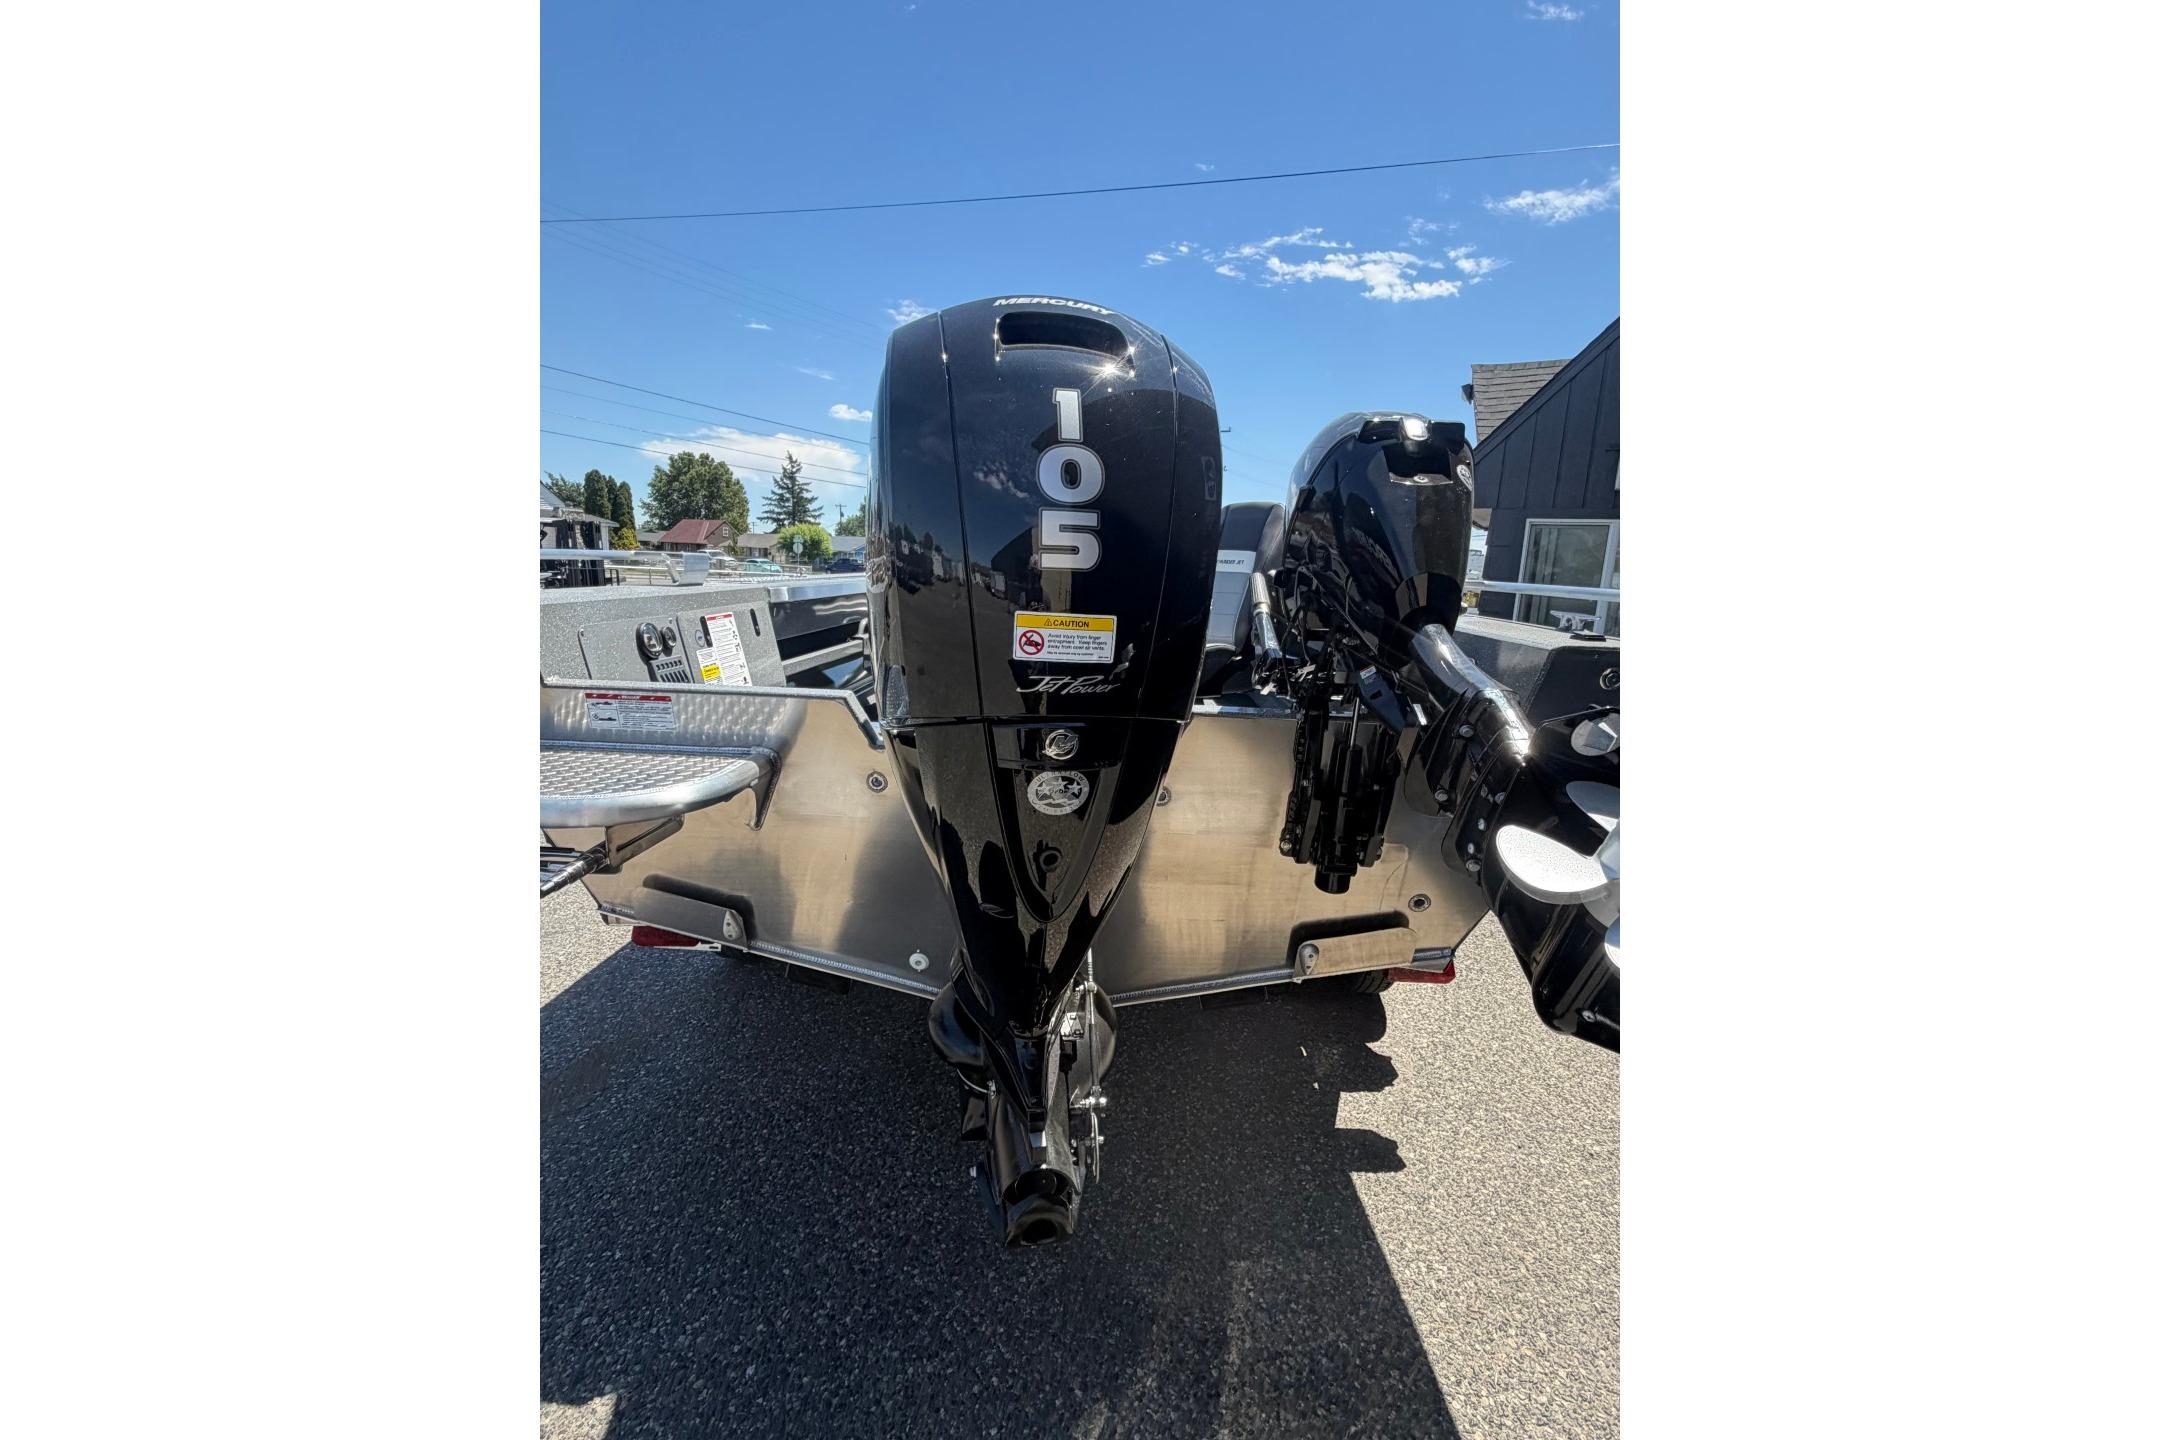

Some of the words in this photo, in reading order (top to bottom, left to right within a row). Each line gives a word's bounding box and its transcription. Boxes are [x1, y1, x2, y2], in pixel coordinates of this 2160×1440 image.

[993, 297, 1116, 315] MERCURY
[1036, 387, 1105, 571] 105
[1053, 619, 1090, 628] CAUTION
